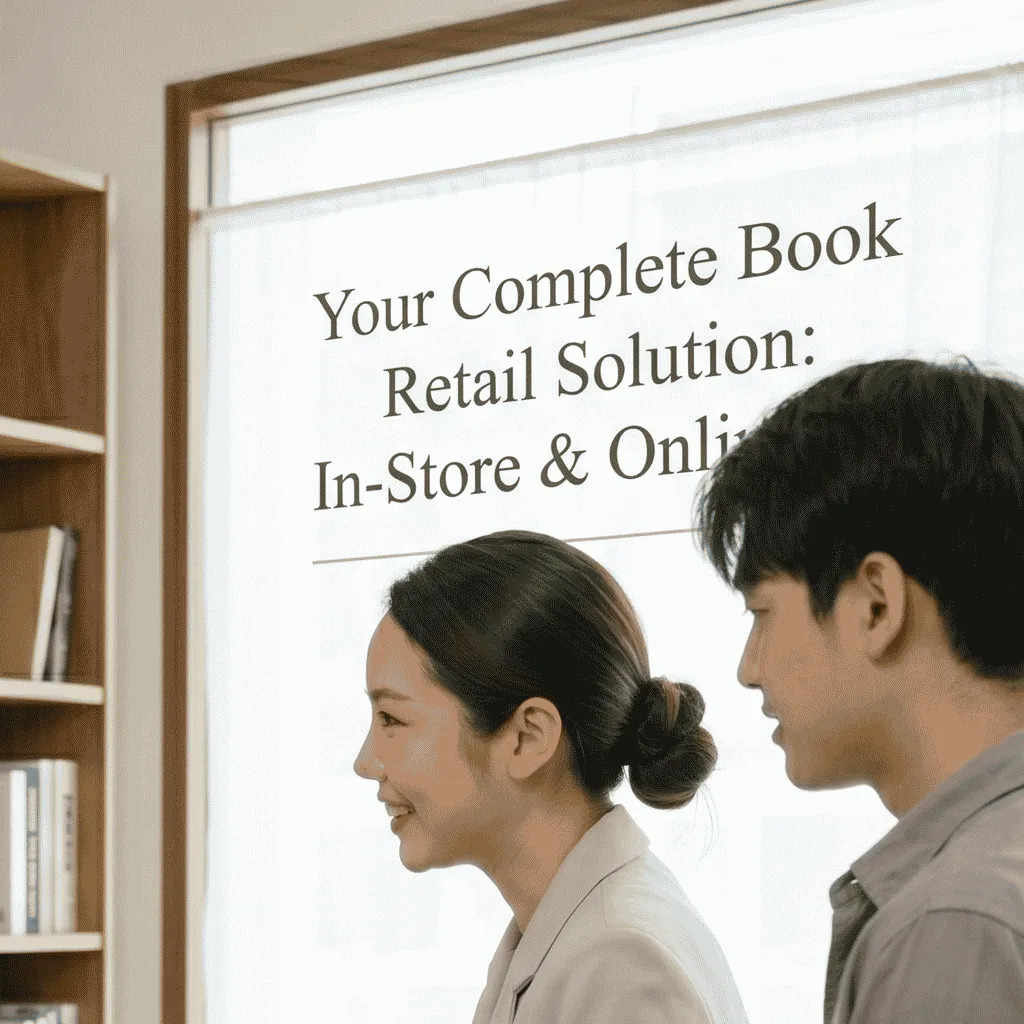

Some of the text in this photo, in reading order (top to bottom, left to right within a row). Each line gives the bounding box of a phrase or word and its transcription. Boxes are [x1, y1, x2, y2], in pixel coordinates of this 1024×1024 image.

[312, 201, 904, 341] Your Complete Book
[383, 320, 814, 418] Retail Solution:
[313, 413, 747, 511] In-Store & Onli
